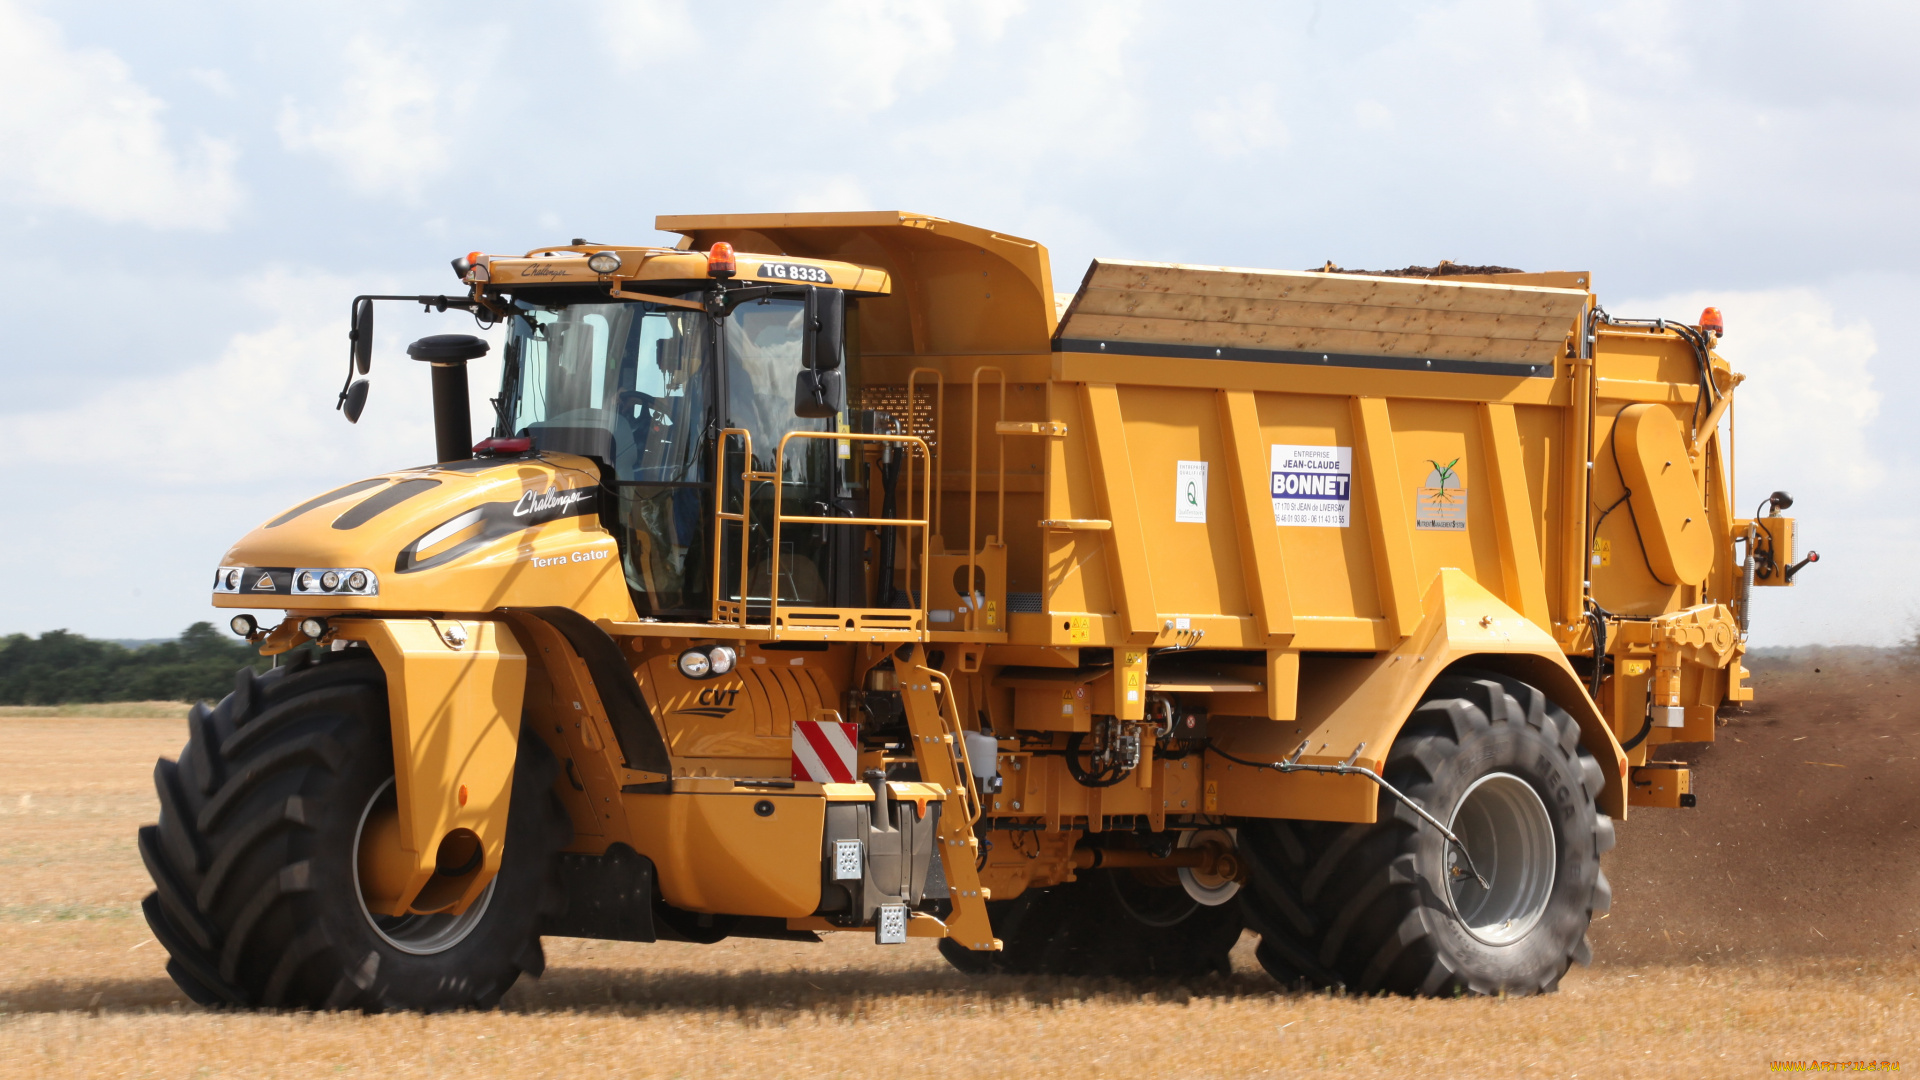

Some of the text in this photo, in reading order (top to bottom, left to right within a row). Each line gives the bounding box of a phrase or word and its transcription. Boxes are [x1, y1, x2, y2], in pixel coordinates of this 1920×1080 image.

[521, 263, 573, 281] Challenger
[763, 263, 827, 282] TG 8333
[1294, 450, 1330, 459] ENTREPRISE
[1283, 459, 1340, 470] JEAN-CLAUDE
[1273, 473, 1349, 496] BONNET
[512, 486, 593, 517] Challenger
[1291, 503, 1296, 511] St
[1297, 503, 1311, 511] JEAN
[1319, 504, 1345, 512] LIVERSAY
[1294, 514, 1300, 523] 93
[1318, 515, 1324, 523] 11
[1332, 516, 1338, 524] 13
[1338, 516, 1345, 524] 55
[531, 549, 609, 568] Terra Gator
[698, 688, 740, 706] CVT
